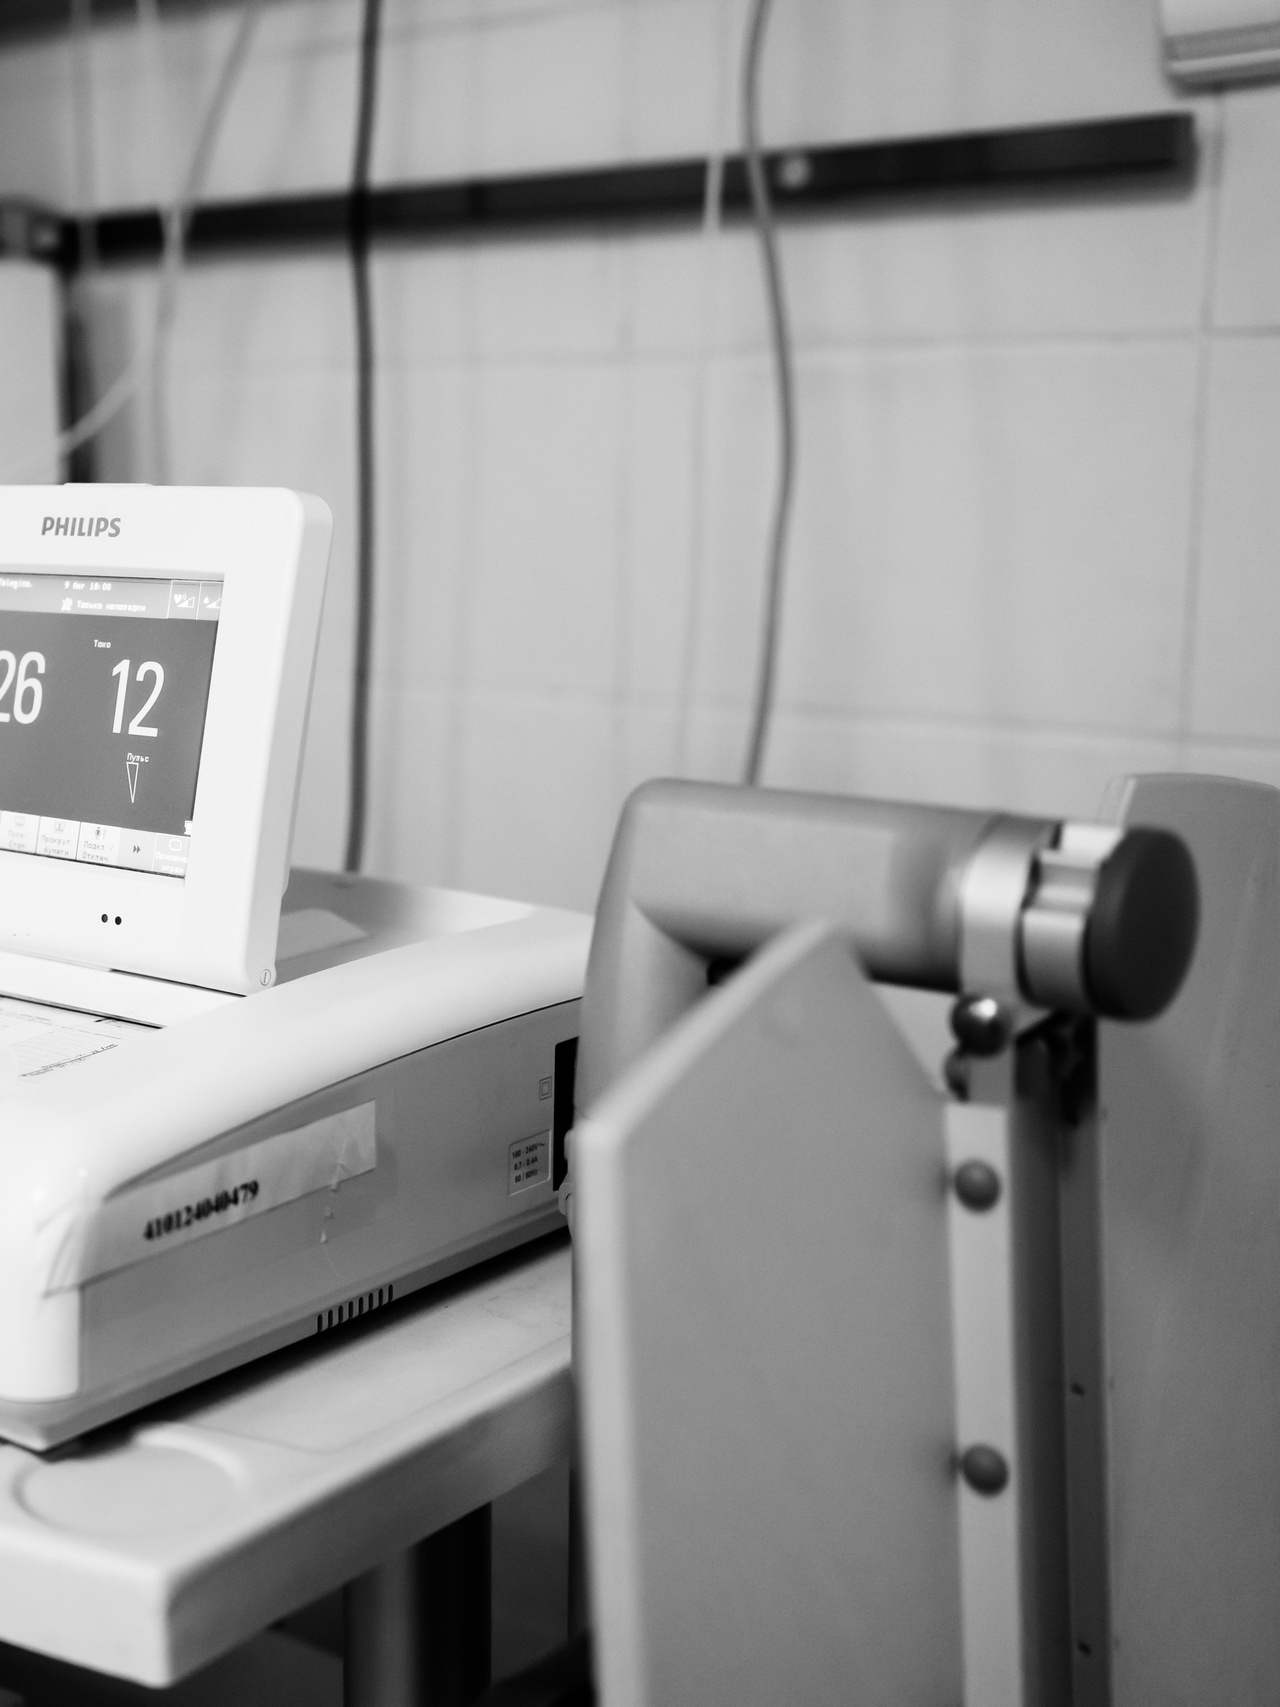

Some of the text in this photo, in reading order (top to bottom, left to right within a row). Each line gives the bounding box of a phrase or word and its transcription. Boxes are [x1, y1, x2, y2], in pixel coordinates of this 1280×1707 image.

[41, 516, 121, 538] PHILIPS
[76, 599, 146, 613] Только неполадки
[112, 659, 165, 738] 12
[126, 752, 150, 763] Пульс
[41, 834, 71, 846] Прокрут
[43, 847, 70, 857] бумаги
[160, 864, 184, 874] экран
[512, 1149, 521, 1159] 100
